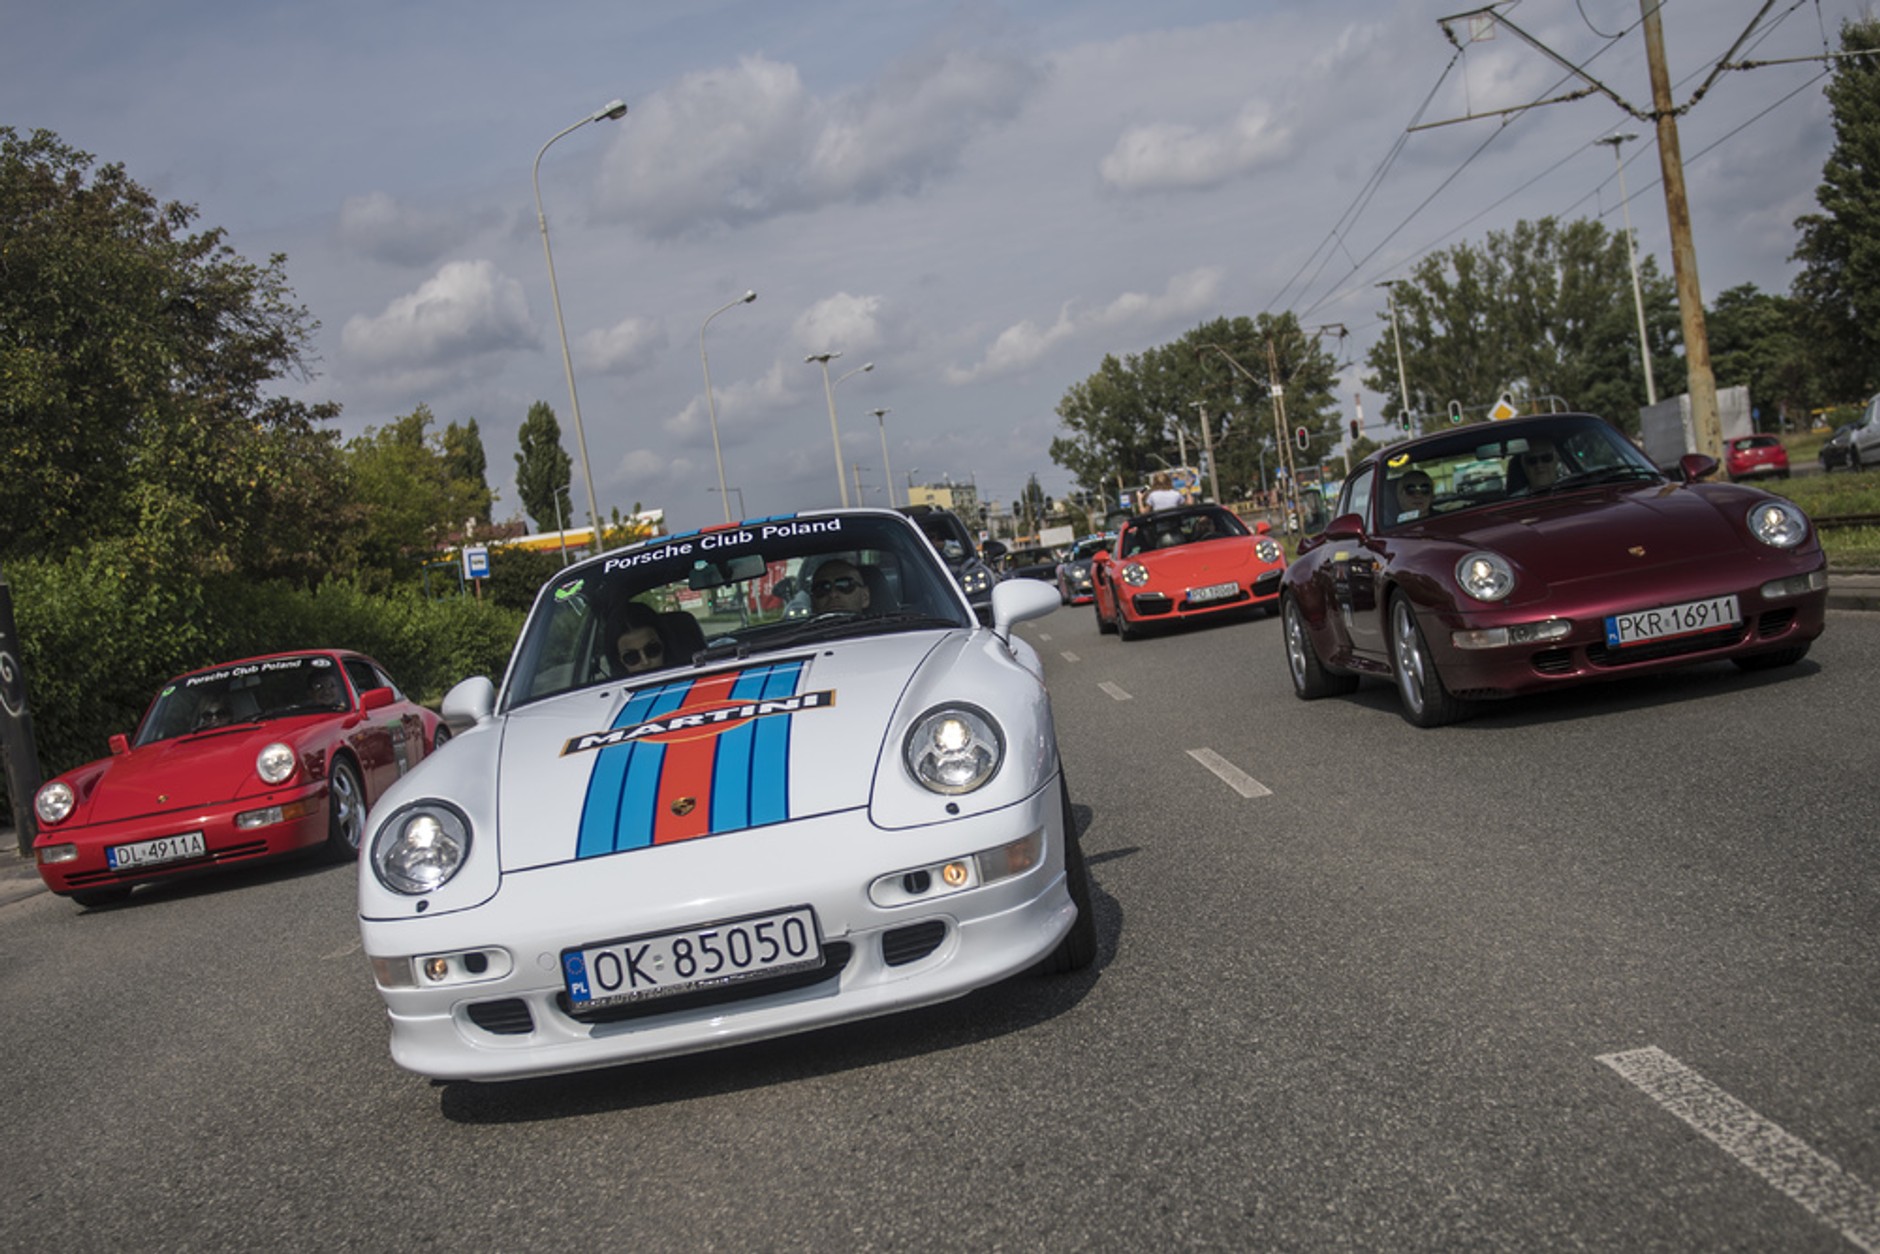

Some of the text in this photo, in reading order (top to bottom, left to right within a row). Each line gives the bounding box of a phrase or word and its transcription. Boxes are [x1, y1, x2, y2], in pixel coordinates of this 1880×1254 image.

[603, 518, 842, 574] Porsche Club Poland
[1619, 599, 1734, 640] PKR 16911
[186, 670, 230, 687] Porsche
[232, 665, 259, 677] Club
[261, 659, 302, 672] Poland
[577, 694, 819, 749] MARTINI
[117, 836, 202, 864] DL 4911A
[594, 917, 808, 991] OK 85050
[571, 981, 588, 995] PL
